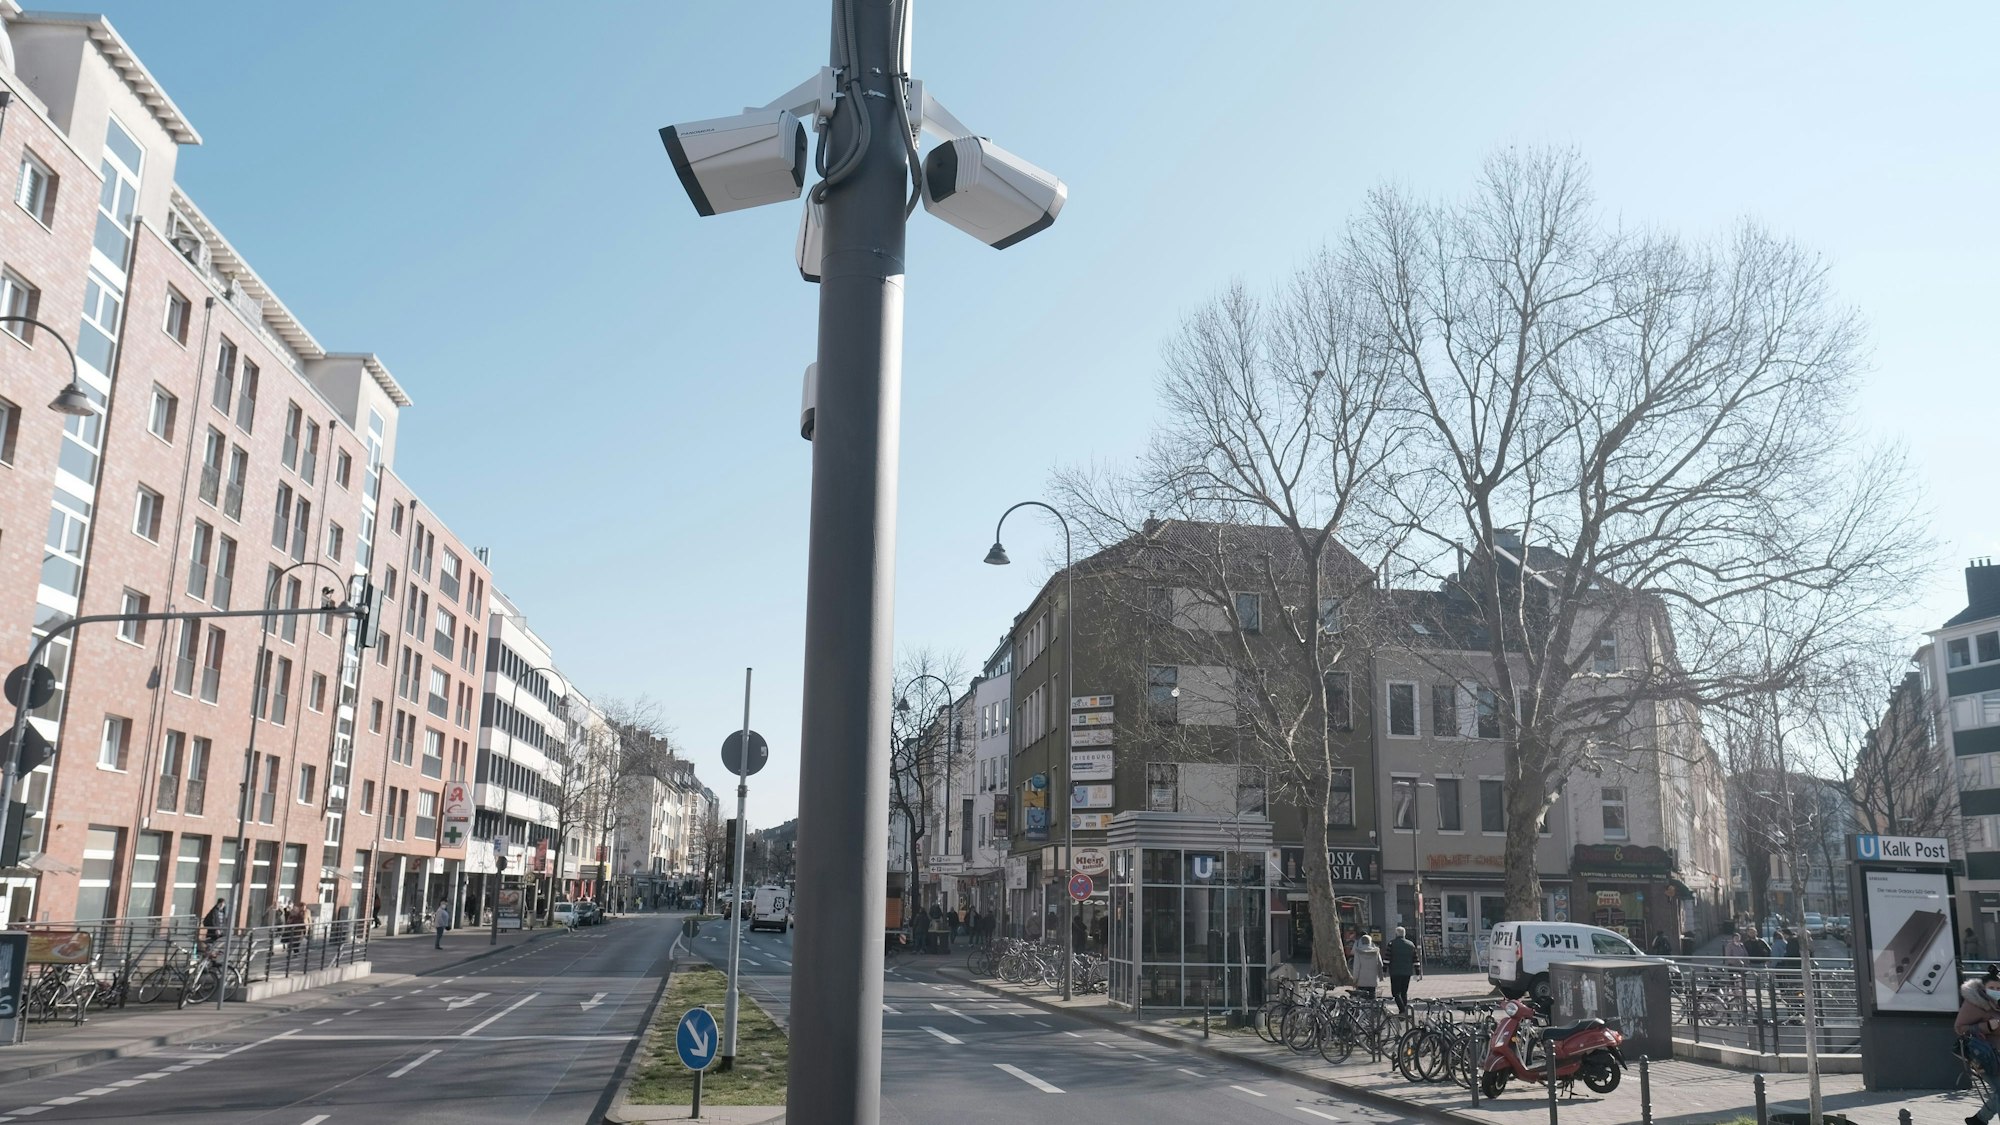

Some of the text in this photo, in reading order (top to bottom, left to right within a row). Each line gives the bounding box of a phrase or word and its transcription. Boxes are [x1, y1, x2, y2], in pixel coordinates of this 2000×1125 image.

[1859, 837, 1946, 858] U Kalk Post
[1194, 857, 1213, 879] U
[1493, 930, 1514, 946] OPTI
[1535, 933, 1579, 949] OPTI
